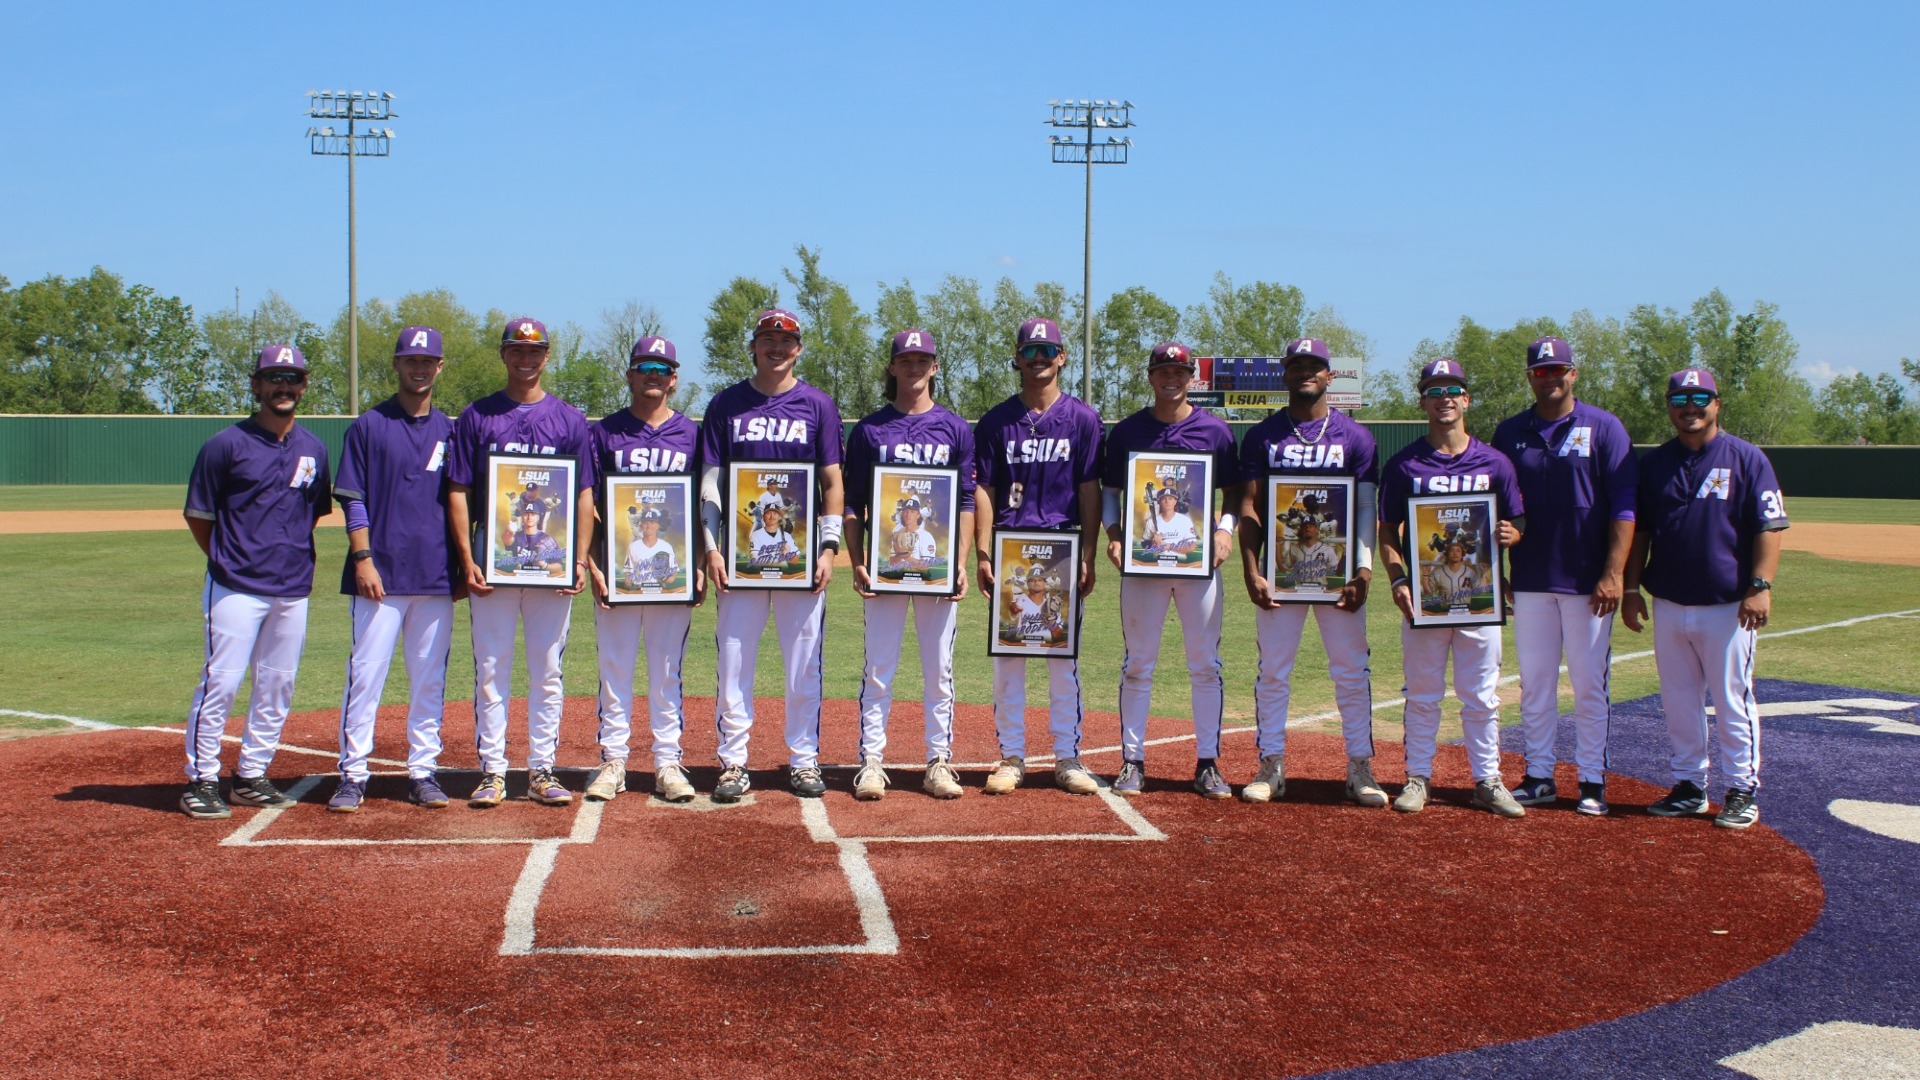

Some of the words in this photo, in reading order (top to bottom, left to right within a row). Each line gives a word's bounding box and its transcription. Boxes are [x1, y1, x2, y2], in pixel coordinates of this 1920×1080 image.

[410, 331, 428, 348] A
[1029, 323, 1047, 339] A
[649, 339, 666, 355] A
[904, 332, 922, 348] A
[1295, 339, 1312, 353] A
[275, 347, 295, 364] A
[1537, 342, 1554, 360] A
[1432, 360, 1450, 375] A
[1680, 371, 1700, 387] A
[1229, 394, 1267, 405] LSUA
[733, 416, 808, 444] LSUA
[1558, 426, 1592, 458] A
[614, 447, 687, 473] LSUA
[879, 443, 950, 466] LSUA
[1006, 438, 1071, 465] LSUA
[1268, 444, 1345, 469] LSUA
[289, 455, 318, 489] A
[518, 470, 550, 482] LSUA
[1155, 464, 1186, 475] LSUA
[900, 479, 932, 490] LSUA
[1413, 474, 1489, 494] LSUA
[1696, 467, 1731, 500] A
[634, 489, 666, 499] LSUA
[1008, 481, 1024, 509] 6
[1760, 489, 1788, 519] 31
[1437, 508, 1471, 519] LSUA
[1021, 544, 1053, 555] LSUA
